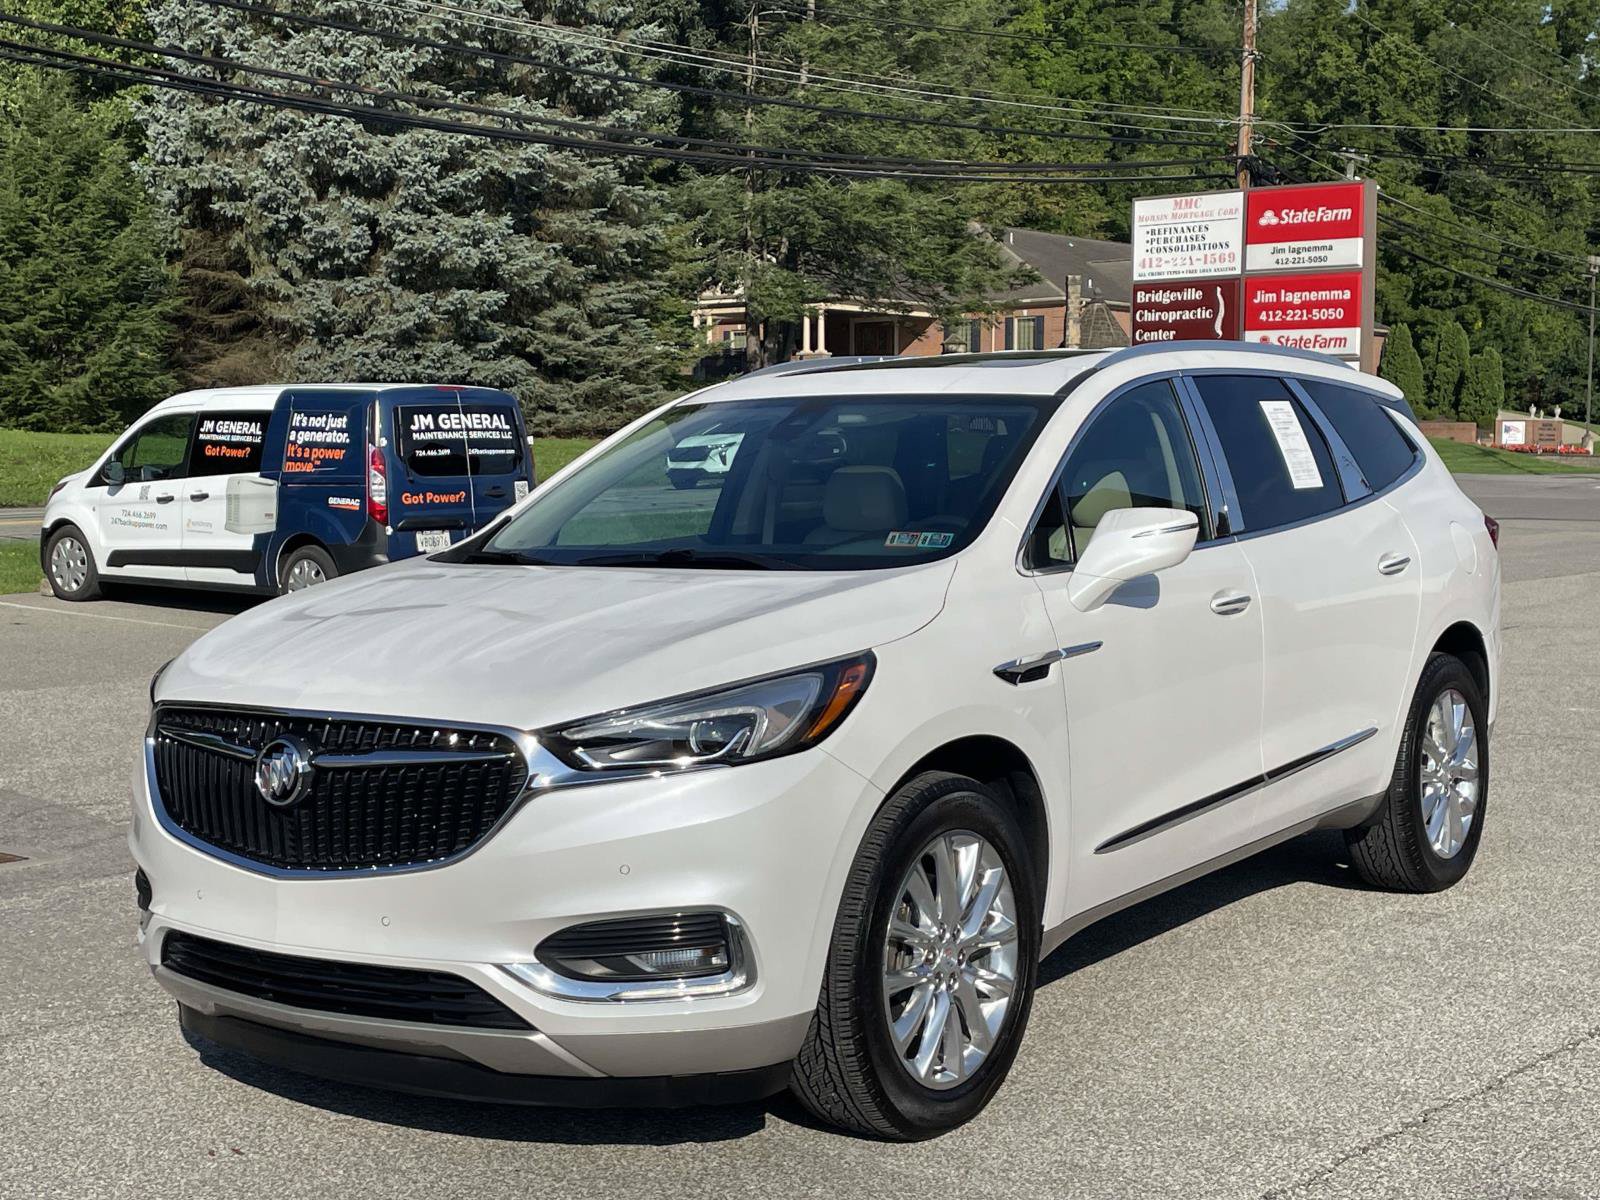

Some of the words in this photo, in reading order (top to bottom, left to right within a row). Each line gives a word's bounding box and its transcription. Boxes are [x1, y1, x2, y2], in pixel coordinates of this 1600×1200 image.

[1172, 198, 1202, 210] MMC
[1171, 211, 1214, 220] MORTGAGE
[1150, 224, 1209, 236] REFINANCES
[1150, 234, 1206, 245] PURCHASES
[1150, 241, 1230, 254] CONSOLIDATIONS
[1270, 246, 1286, 255] Jim
[1138, 252, 1236, 269] 412-221-1569
[1275, 255, 1328, 265] 412-221-5050
[1136, 288, 1203, 305] Bridgeville
[1253, 290, 1277, 303] Jim
[1136, 306, 1214, 323] Chiropractic
[1259, 308, 1344, 321] 412-221-5050
[1135, 329, 1176, 341] Center
[200, 420, 215, 433] JM
[216, 421, 262, 435] GENERAL
[292, 413, 308, 428] It's
[308, 414, 327, 428] not
[325, 413, 348, 431] just
[410, 414, 435, 430] JM
[438, 414, 511, 429] GENERAL
[289, 430, 297, 441] a
[297, 430, 350, 444] generator.
[412, 431, 468, 440] MAINTENANCE
[468, 431, 501, 439] SERVICES
[501, 431, 513, 439] LLC
[205, 445, 220, 456] Got
[220, 446, 251, 458] Power?
[287, 443, 303, 457] It's
[303, 447, 310, 458] a
[311, 447, 346, 461] power
[328, 496, 360, 506] GENERAC
[402, 492, 424, 504] Got
[426, 491, 466, 503] Power?
